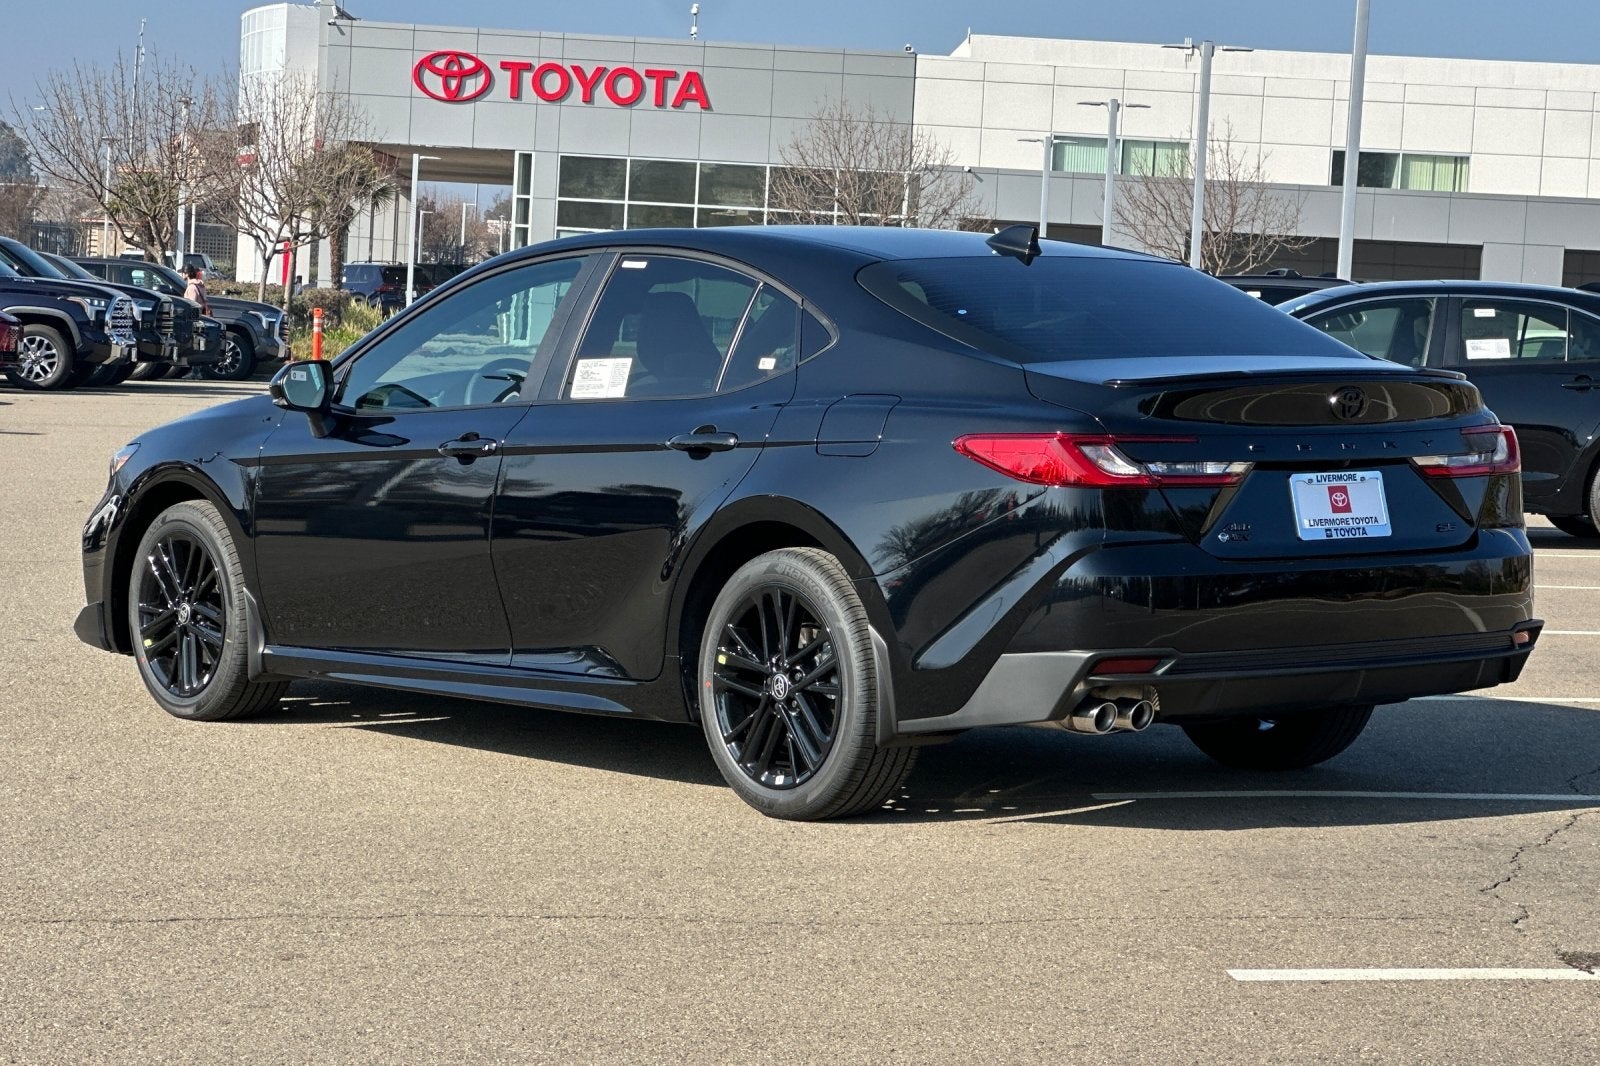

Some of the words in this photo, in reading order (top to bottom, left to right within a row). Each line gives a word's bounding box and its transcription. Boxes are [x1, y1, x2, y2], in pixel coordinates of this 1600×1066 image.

[500, 61, 710, 110] TOYOTA
[1315, 474, 1358, 483] LIVERMORE
[1308, 519, 1350, 528] LIVERMORE
[1352, 516, 1379, 526] TOYOTA
[1333, 527, 1368, 537] TOYOTA
